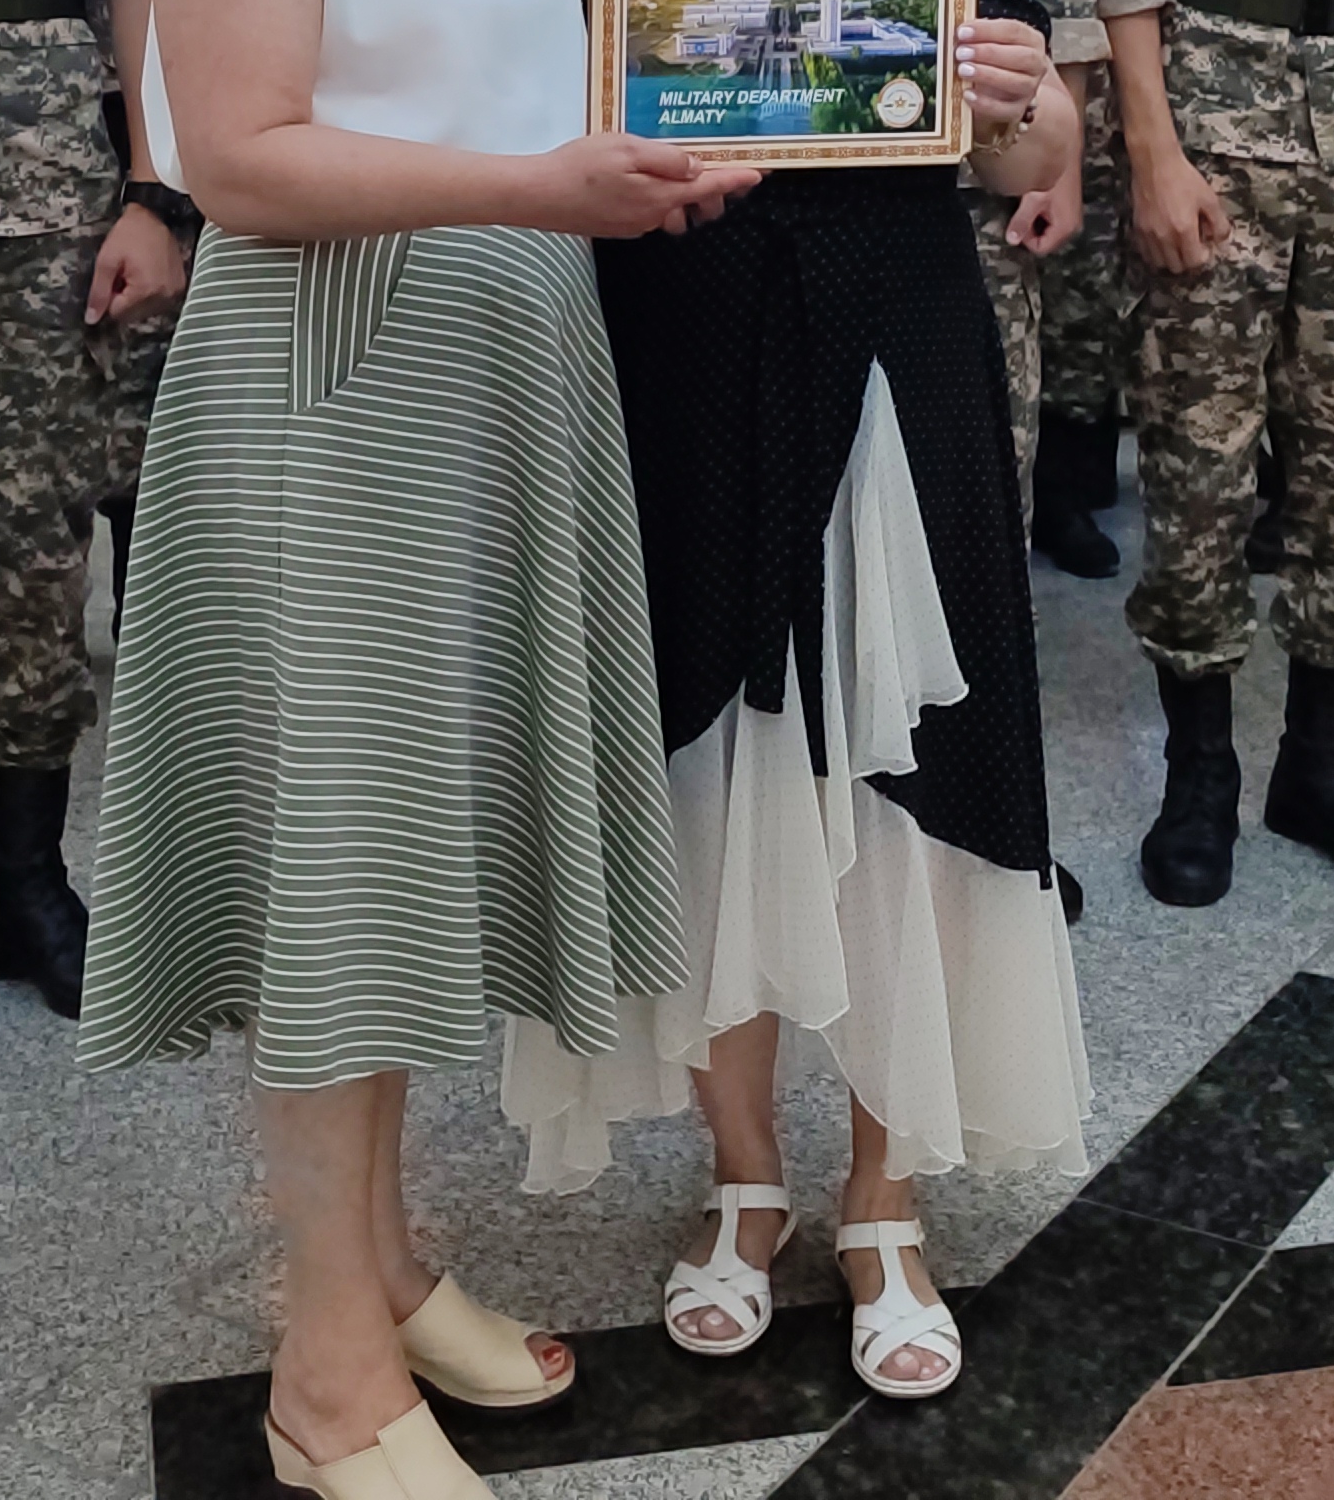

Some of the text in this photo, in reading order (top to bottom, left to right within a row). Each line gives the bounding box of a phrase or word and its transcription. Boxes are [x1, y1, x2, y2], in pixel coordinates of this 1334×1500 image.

[659, 88, 846, 107] MILITARY DEPARTMENT
[657, 108, 728, 125] ALMATY
